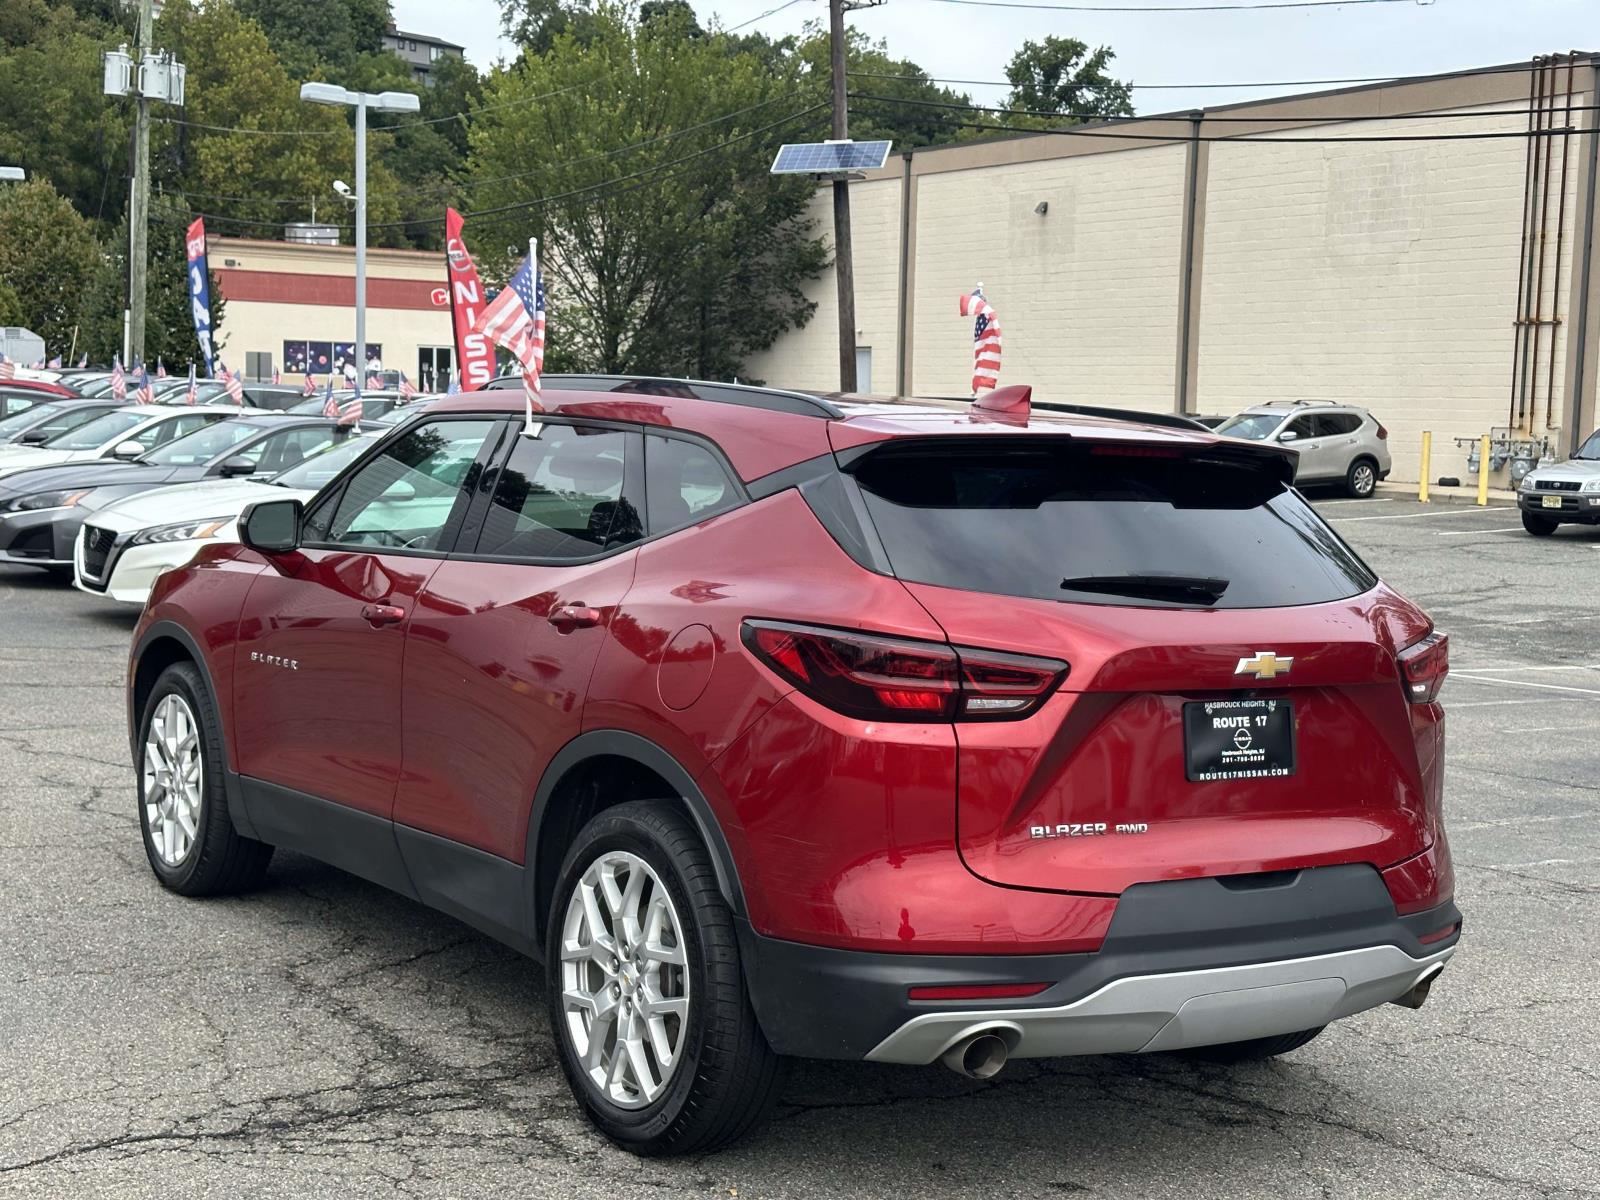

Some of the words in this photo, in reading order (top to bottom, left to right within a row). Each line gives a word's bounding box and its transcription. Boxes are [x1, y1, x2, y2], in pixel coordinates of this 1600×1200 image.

[251, 651, 298, 670] BLAZER
[1204, 701, 1240, 709] HASBROUCK
[1268, 700, 1276, 708] NJ
[1213, 716, 1250, 728] ROUTE
[1255, 715, 1267, 727] 17
[1199, 768, 1288, 780] ROUTE17NISSAN.COM
[1030, 822, 1107, 839] BLAZER
[1115, 822, 1149, 834] AWD
